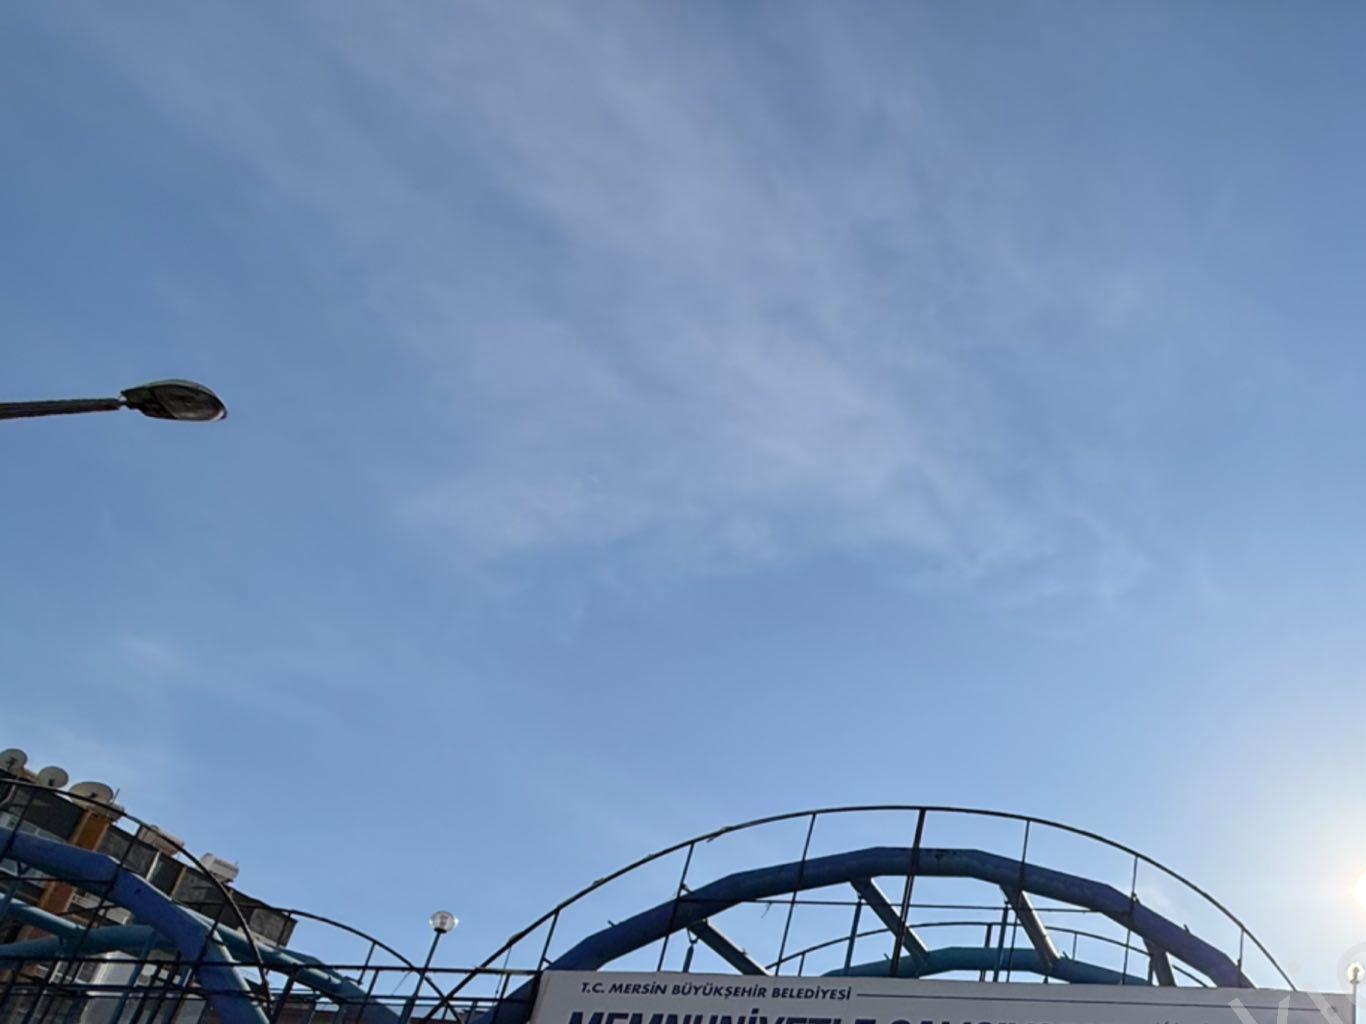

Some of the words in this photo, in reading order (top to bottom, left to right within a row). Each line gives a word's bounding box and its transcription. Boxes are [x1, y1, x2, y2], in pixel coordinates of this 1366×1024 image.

[580, 982, 605, 995] T.C.
[608, 983, 668, 996] MERSİN
[671, 982, 767, 999] BÜYÜKŞEHİR
[771, 986, 852, 1001] BELEDİYESİ
